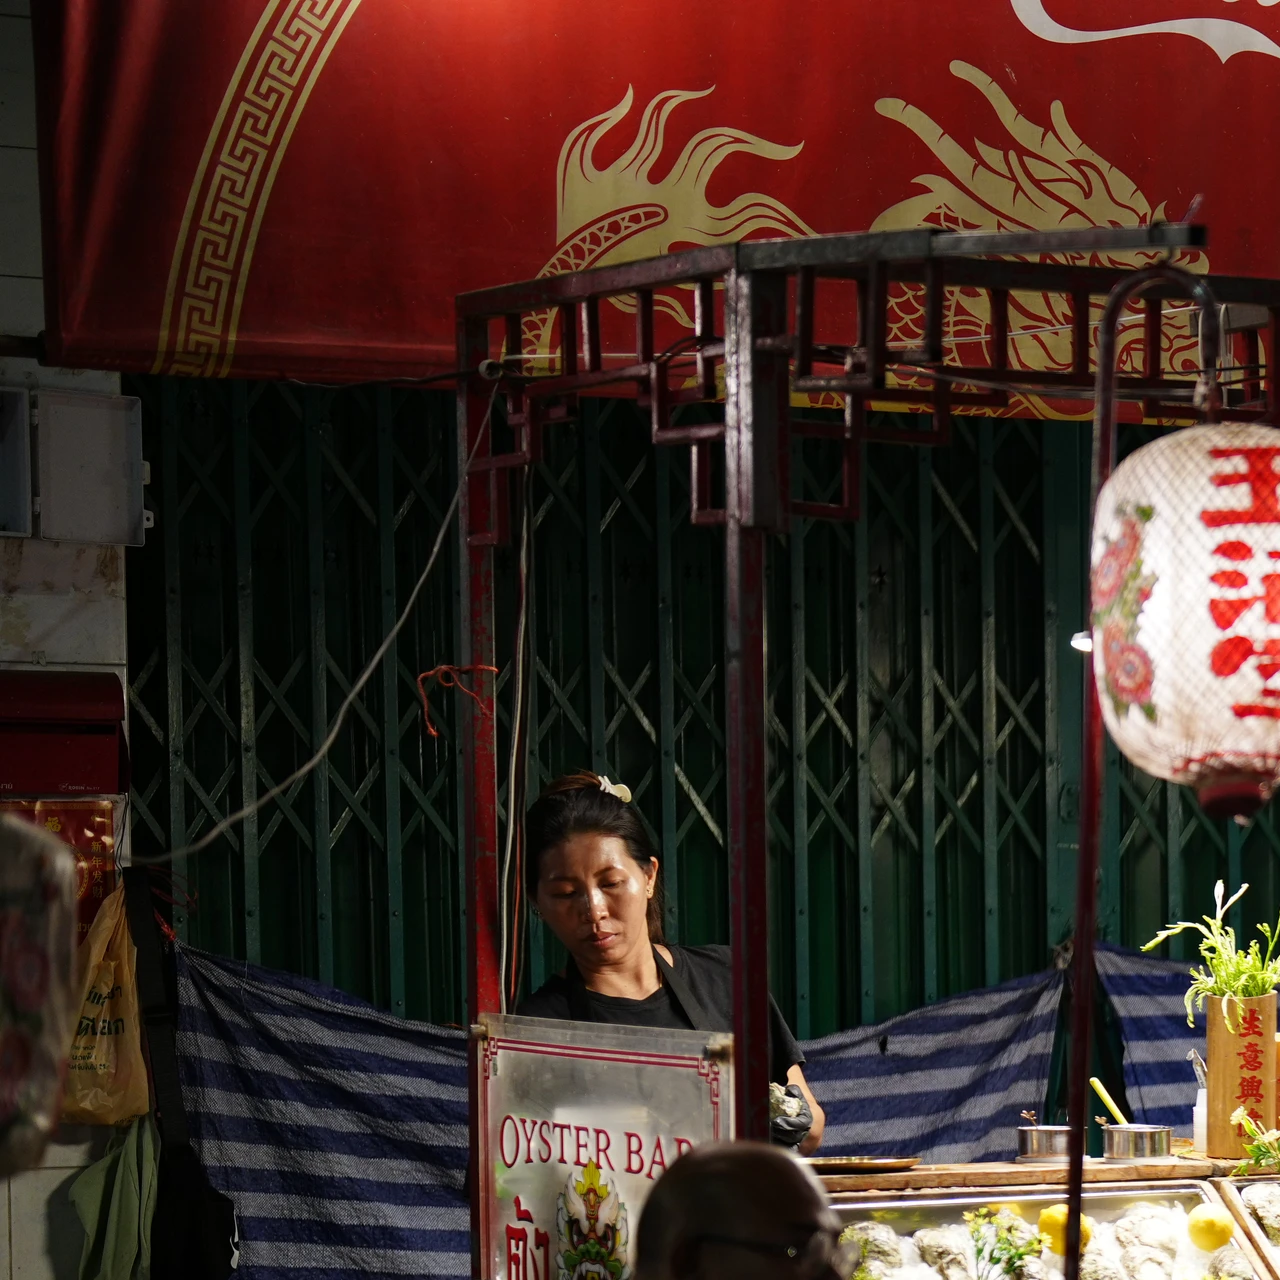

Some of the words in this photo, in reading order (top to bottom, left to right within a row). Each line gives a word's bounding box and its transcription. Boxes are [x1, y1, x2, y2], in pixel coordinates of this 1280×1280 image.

[91, 840, 104, 899] 新年发财
[500, 1115, 615, 1172] OYSTER
